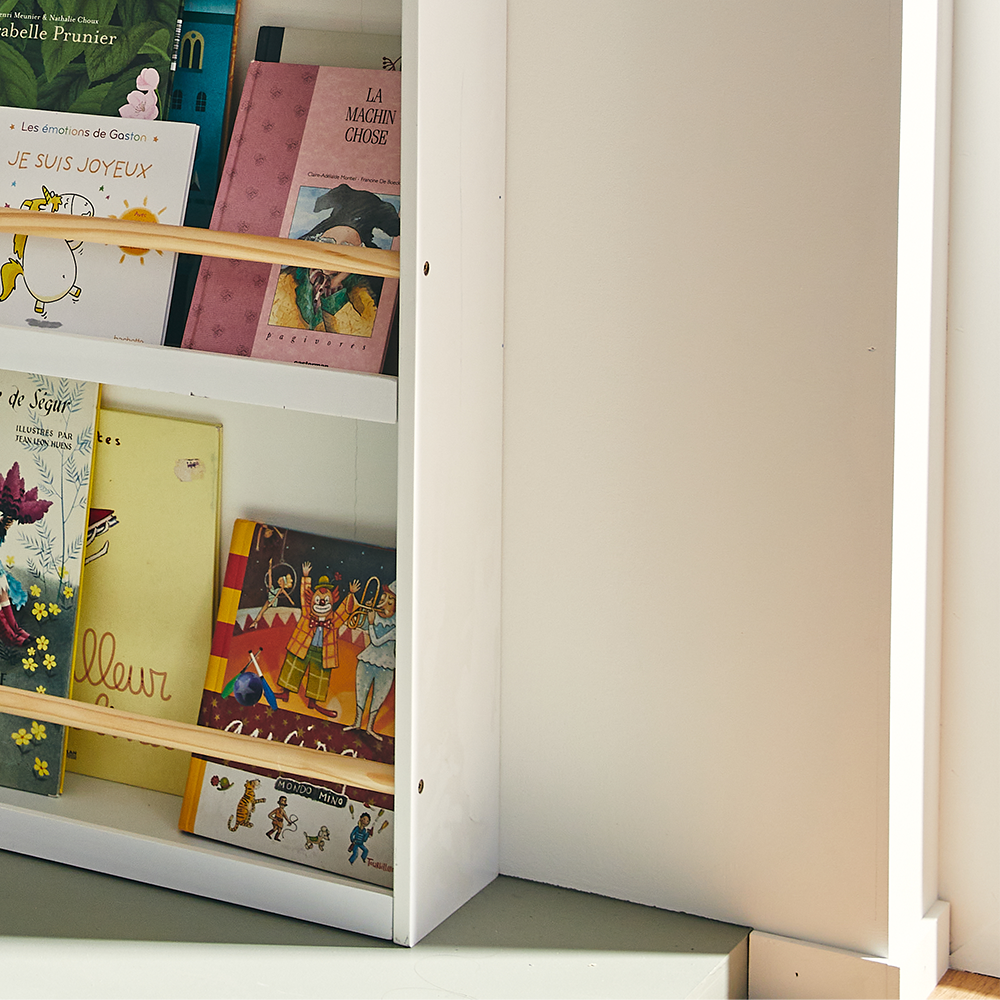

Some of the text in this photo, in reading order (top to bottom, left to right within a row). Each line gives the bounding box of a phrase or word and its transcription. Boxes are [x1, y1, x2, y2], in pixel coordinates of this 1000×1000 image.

[13, 11, 41, 20] Meunier
[42, 13, 47, 21] &
[49, 14, 76, 23] Nathalie
[77, 16, 99, 25] Choux
[52, 25, 118, 46] Prunier
[366, 87, 383, 103] LA
[345, 106, 397, 125] MACHIN
[21, 121, 147, 142] Les émotions de Gaston
[344, 126, 389, 145] CHOSE
[7, 150, 153, 179] JE SUIS JOYEUX
[8, 384, 25, 413] de
[29, 388, 73, 417] Ségur
[15, 434, 32, 444] JEAN
[50, 440, 72, 451] HUENS
[57, 430, 73, 440] PAR
[277, 780, 344, 806] MONDO MINO
